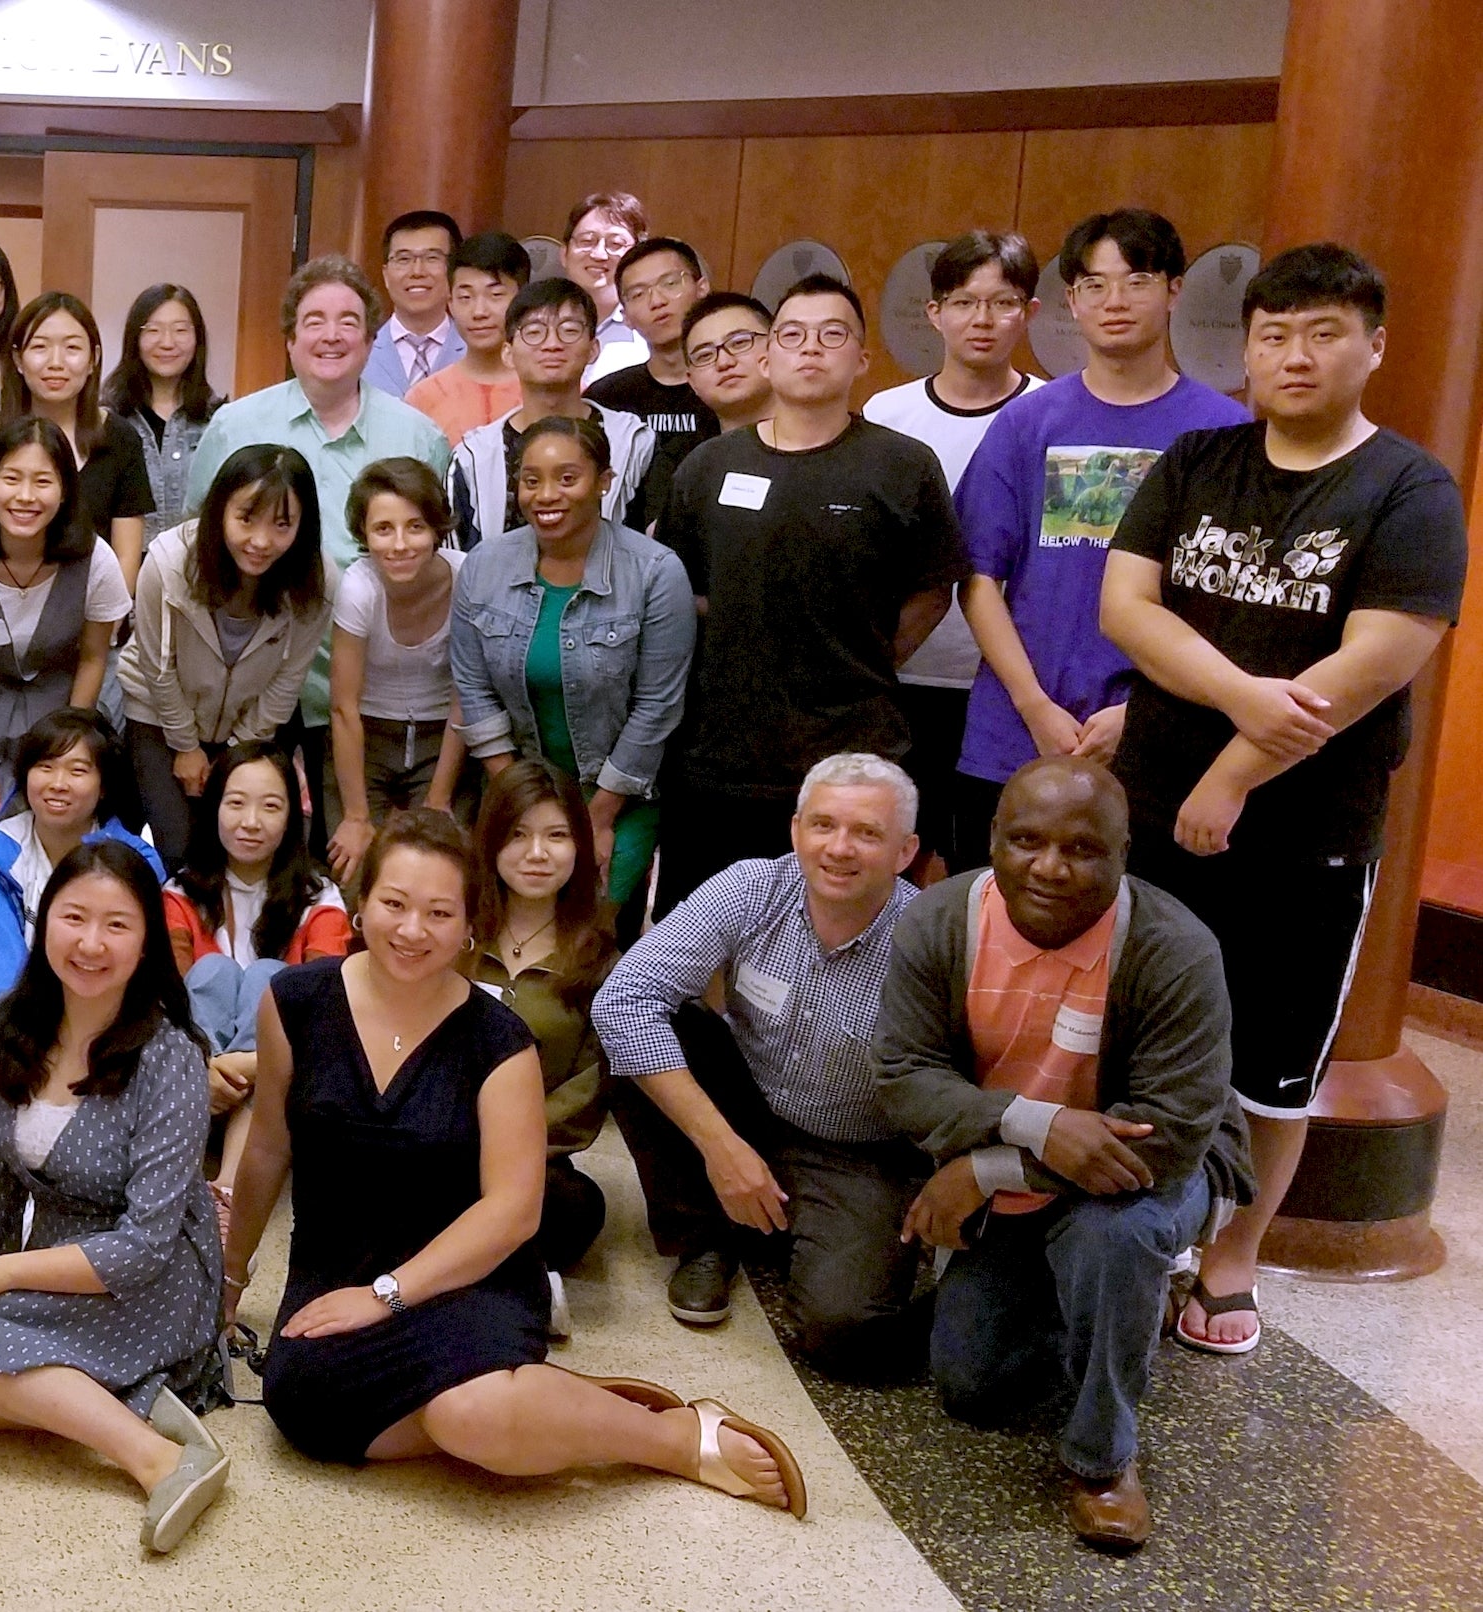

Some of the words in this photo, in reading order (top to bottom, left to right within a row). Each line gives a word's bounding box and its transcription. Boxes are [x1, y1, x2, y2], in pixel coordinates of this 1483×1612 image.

[92, 37, 233, 77] EVANS
[646, 413, 697, 432] NIRVANA
[1038, 535, 1082, 548] BELOW
[1088, 538, 1110, 549] THE
[1179, 514, 1274, 566] Jack
[1170, 546, 1332, 614] Wolfskin
